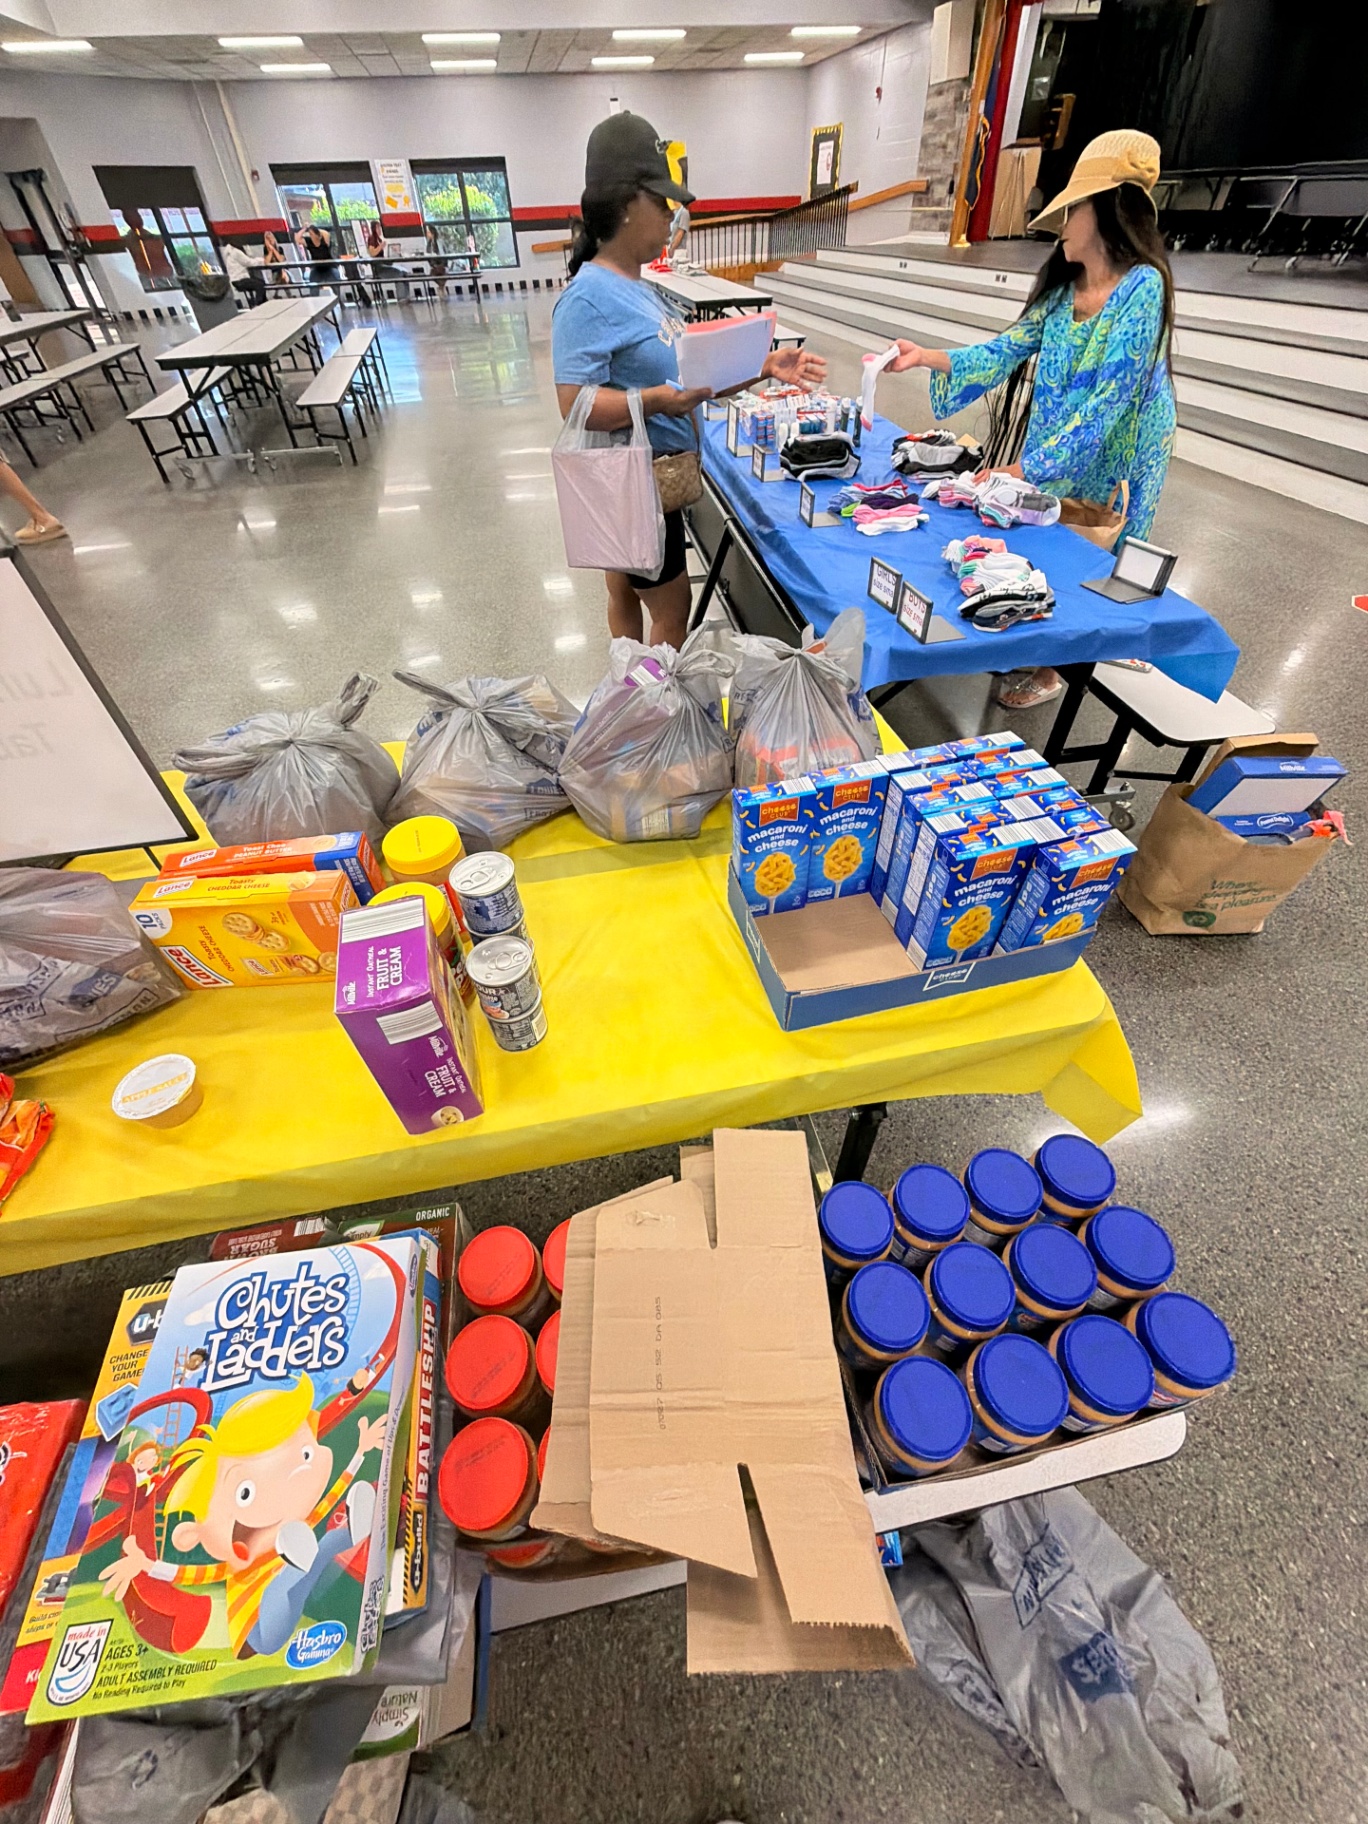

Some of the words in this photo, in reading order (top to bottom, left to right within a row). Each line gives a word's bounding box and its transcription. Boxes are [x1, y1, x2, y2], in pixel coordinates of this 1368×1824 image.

[836, 785, 869, 797] cheese
[762, 804, 797, 816] cheese
[819, 807, 877, 826] macaroni
[747, 824, 808, 843] macaroni
[825, 821, 869, 836] cheese
[754, 839, 800, 853] cheese
[183, 850, 215, 863] Lance
[977, 854, 1013, 868] cheese
[1078, 864, 1113, 876] cheese
[954, 875, 1018, 897] macaroni
[976, 886, 992, 894] and
[1052, 882, 1114, 906] macaroni
[958, 890, 1004, 907] cheese
[1054, 898, 1098, 915] cheese
[1073, 894, 1089, 902] and
[135, 914, 158, 930] 10
[377, 947, 387, 956] &
[167, 948, 223, 986] Lance
[376, 958, 389, 991] FRUIT
[389, 945, 403, 986] CREAM
[424, 1070, 447, 1098] CREAM
[435, 1064, 456, 1088] FRUIT
[415, 1206, 450, 1221] ORGANIC
[230, 1237, 277, 1255] SUGAR
[217, 1264, 348, 1329] Chutes
[231, 1326, 257, 1344] and
[109, 1348, 149, 1365] CHANGE
[200, 1316, 346, 1392] Ladders
[112, 1360, 138, 1373] YOUR
[416, 1303, 437, 1495] BATTLESHIP
[382, 1457, 391, 1487] Game
[380, 1489, 389, 1530] Exciting
[413, 1513, 424, 1587] u-build
[68, 1626, 95, 1641] made
[96, 1625, 106, 1637] in
[291, 1630, 342, 1651] Hasbro
[60, 1638, 101, 1672] USA
[105, 1644, 134, 1660] AGES
[135, 1643, 149, 1657] 3+
[96, 1673, 126, 1688] ADULT
[126, 1666, 174, 1683] ASSEMBLY
[174, 1659, 218, 1675] REQUIRED
[115, 1661, 139, 1670] Players
[103, 1688, 130, 1699] Reading
[132, 1683, 162, 1694] Required
[171, 1680, 186, 1689] Play
[380, 1690, 419, 1708] Nature
[371, 1706, 410, 1726] Simply
